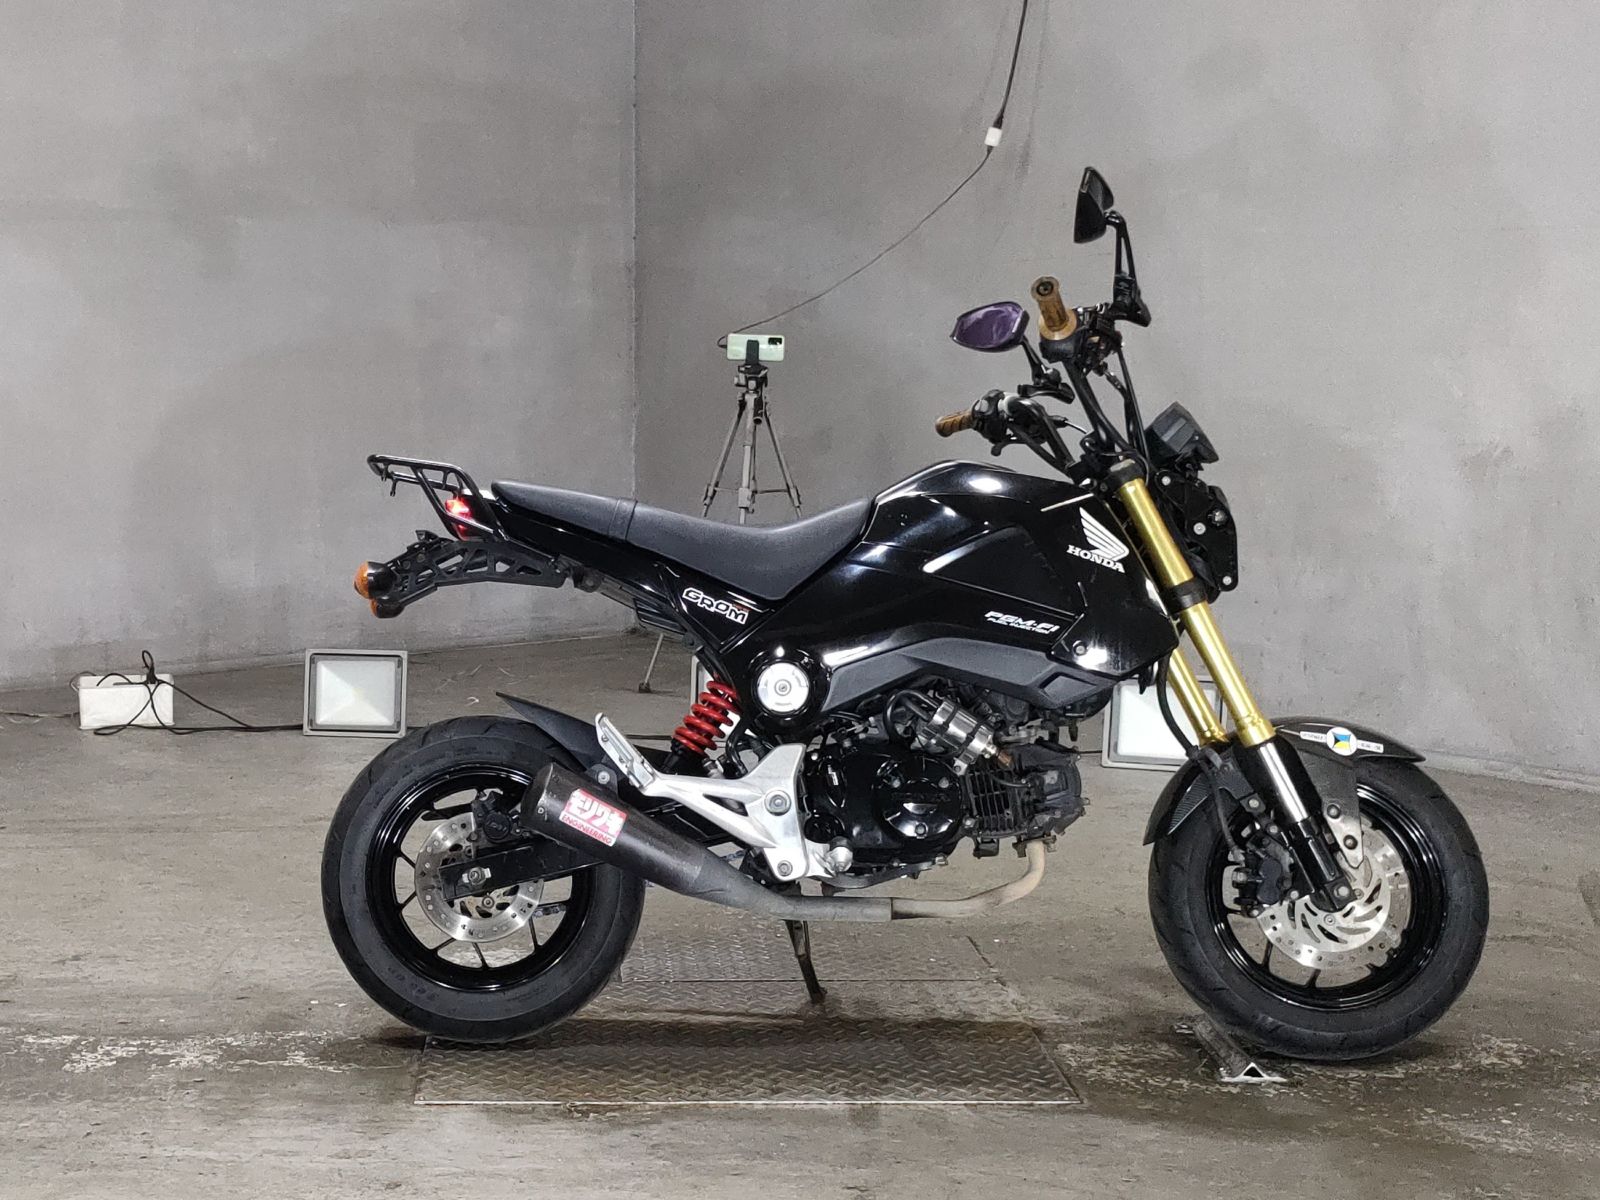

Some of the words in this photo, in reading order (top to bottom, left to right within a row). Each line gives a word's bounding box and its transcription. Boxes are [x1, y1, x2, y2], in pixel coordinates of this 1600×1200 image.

[1066, 544, 1125, 574] HONDA
[682, 587, 749, 625] GROM
[561, 814, 613, 845] ENGINEERING
